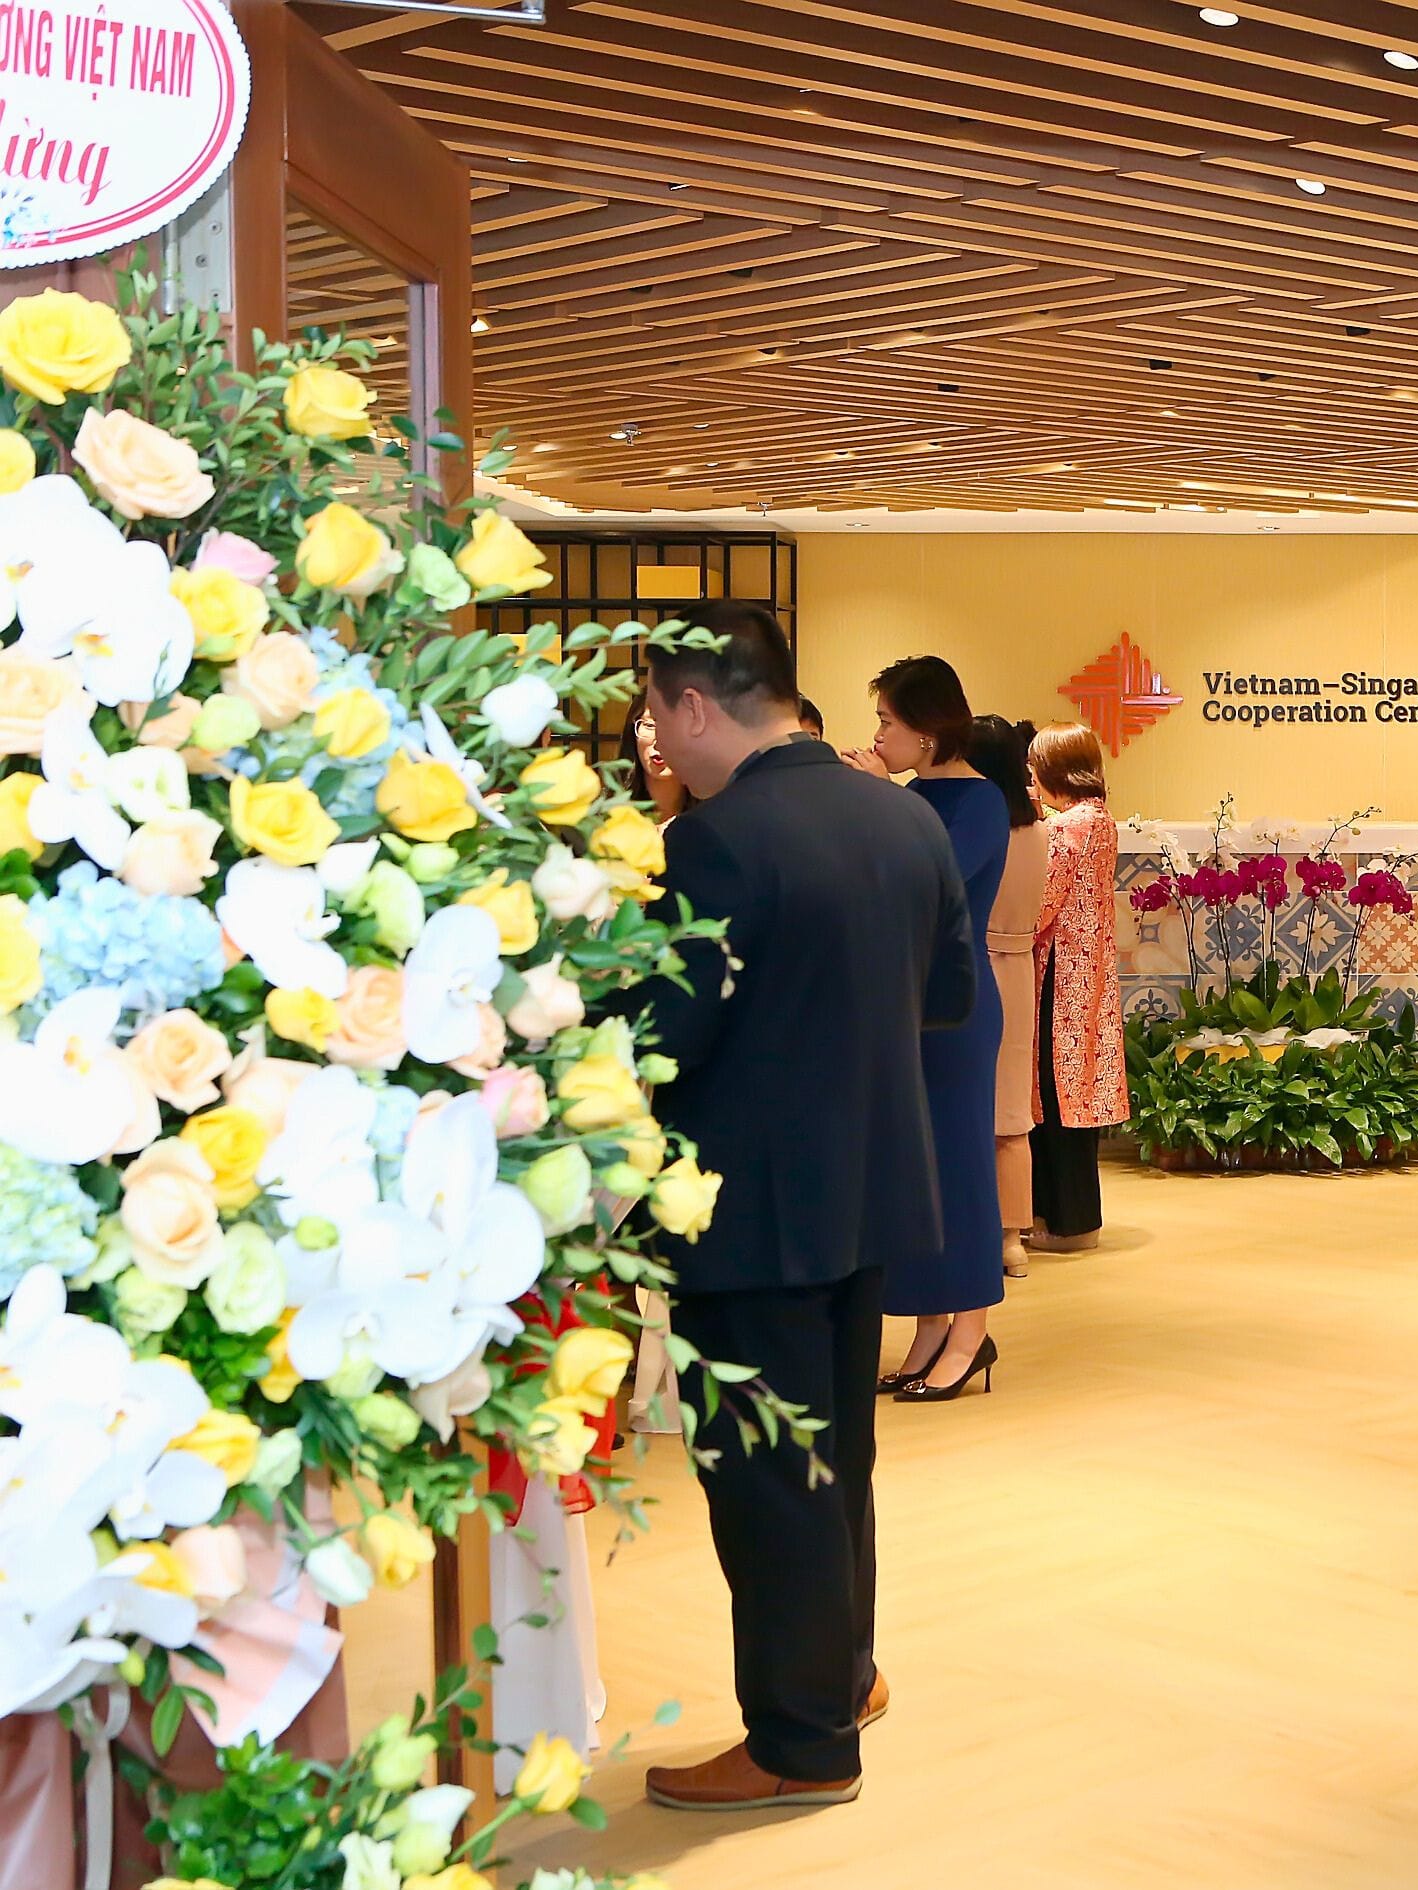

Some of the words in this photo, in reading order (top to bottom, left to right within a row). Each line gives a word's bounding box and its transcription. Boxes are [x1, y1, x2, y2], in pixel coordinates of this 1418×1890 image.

[65, 3, 123, 101] VIỆT
[130, 25, 196, 98] NAM
[0, 97, 112, 206] ừng
[1202, 699, 1367, 728] Cooperation
